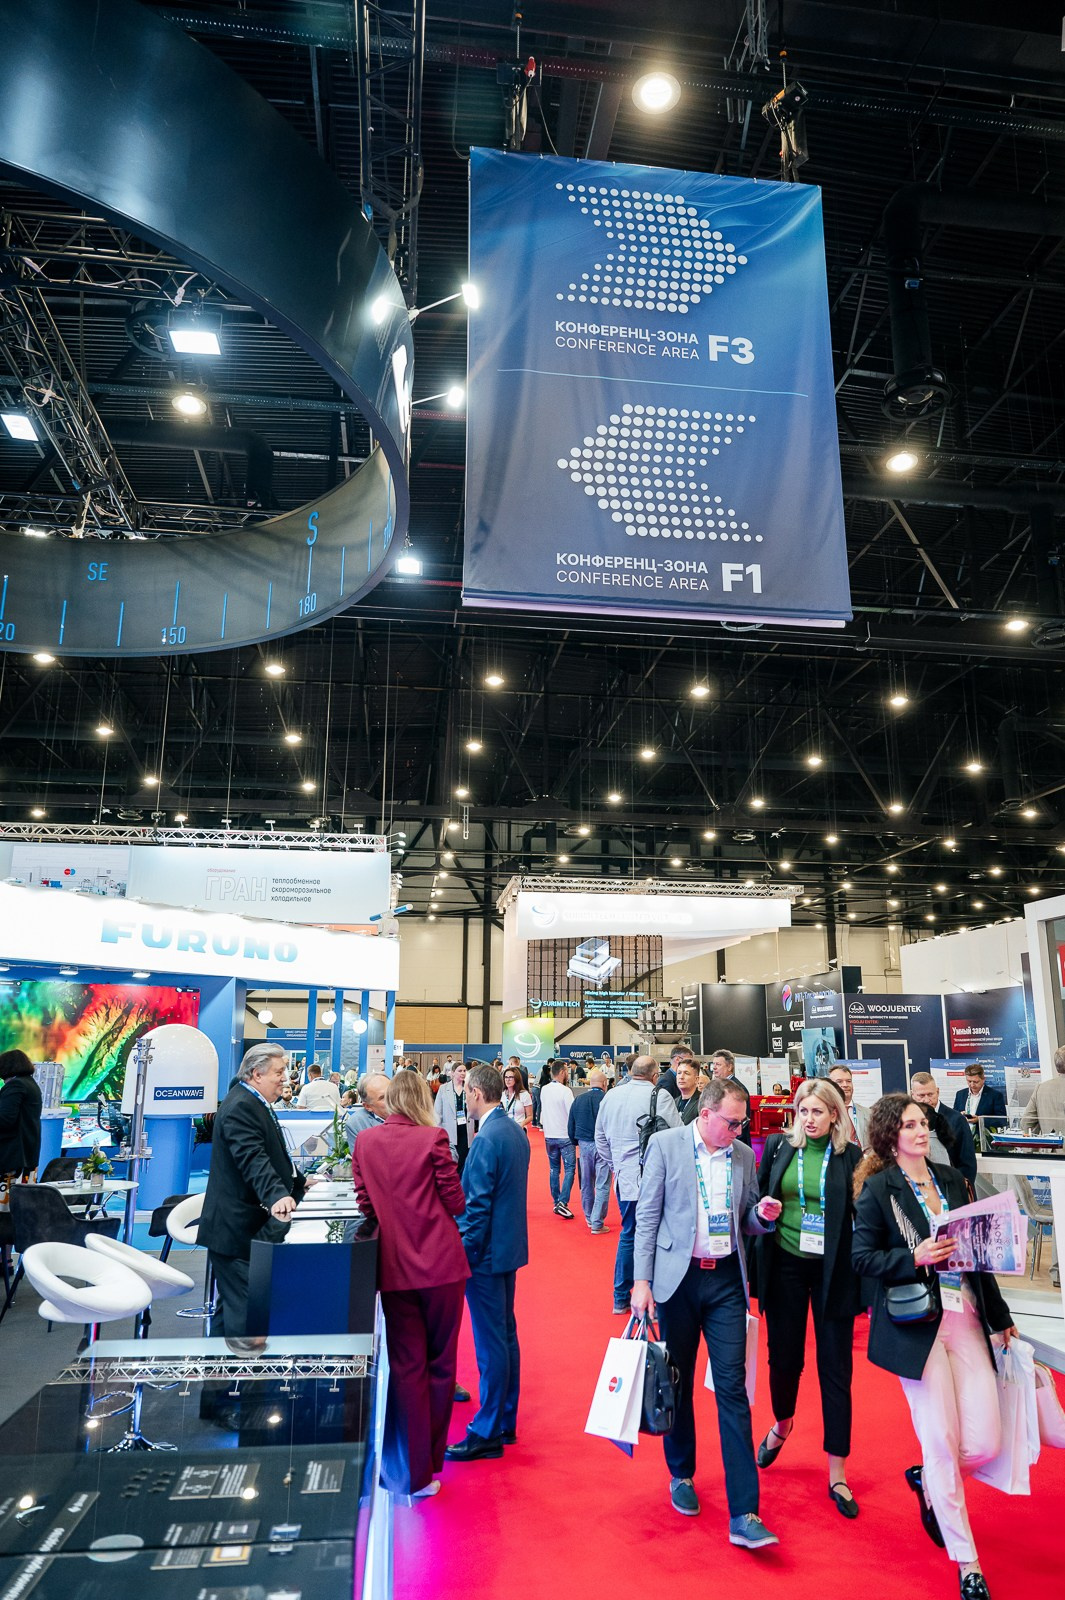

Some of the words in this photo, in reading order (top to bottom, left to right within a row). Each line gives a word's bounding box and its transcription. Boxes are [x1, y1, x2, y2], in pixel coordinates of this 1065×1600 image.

[555, 320, 699, 345] КОНФЕРЕНЦ-ЗОНА
[555, 336, 657, 356] CONFERENCE
[661, 346, 700, 360] AREA
[708, 334, 755, 365] F3
[306, 511, 319, 546] S
[87, 562, 108, 581] SE
[556, 552, 708, 574] КОНФЕРЕНЦ-ЗОНА
[556, 570, 664, 588] CONFERENCE
[668, 577, 709, 591] AREA
[721, 562, 762, 594] F1
[298, 592, 317, 617] 180
[161, 626, 186, 645] 150
[205, 876, 268, 902] ГРАН
[271, 886, 332, 894] скороморозильное
[272, 877, 321, 885] теплообменное
[100, 918, 299, 963] FURUNO
[952, 1026, 972, 1035] Умный
[972, 1027, 990, 1035] завод
